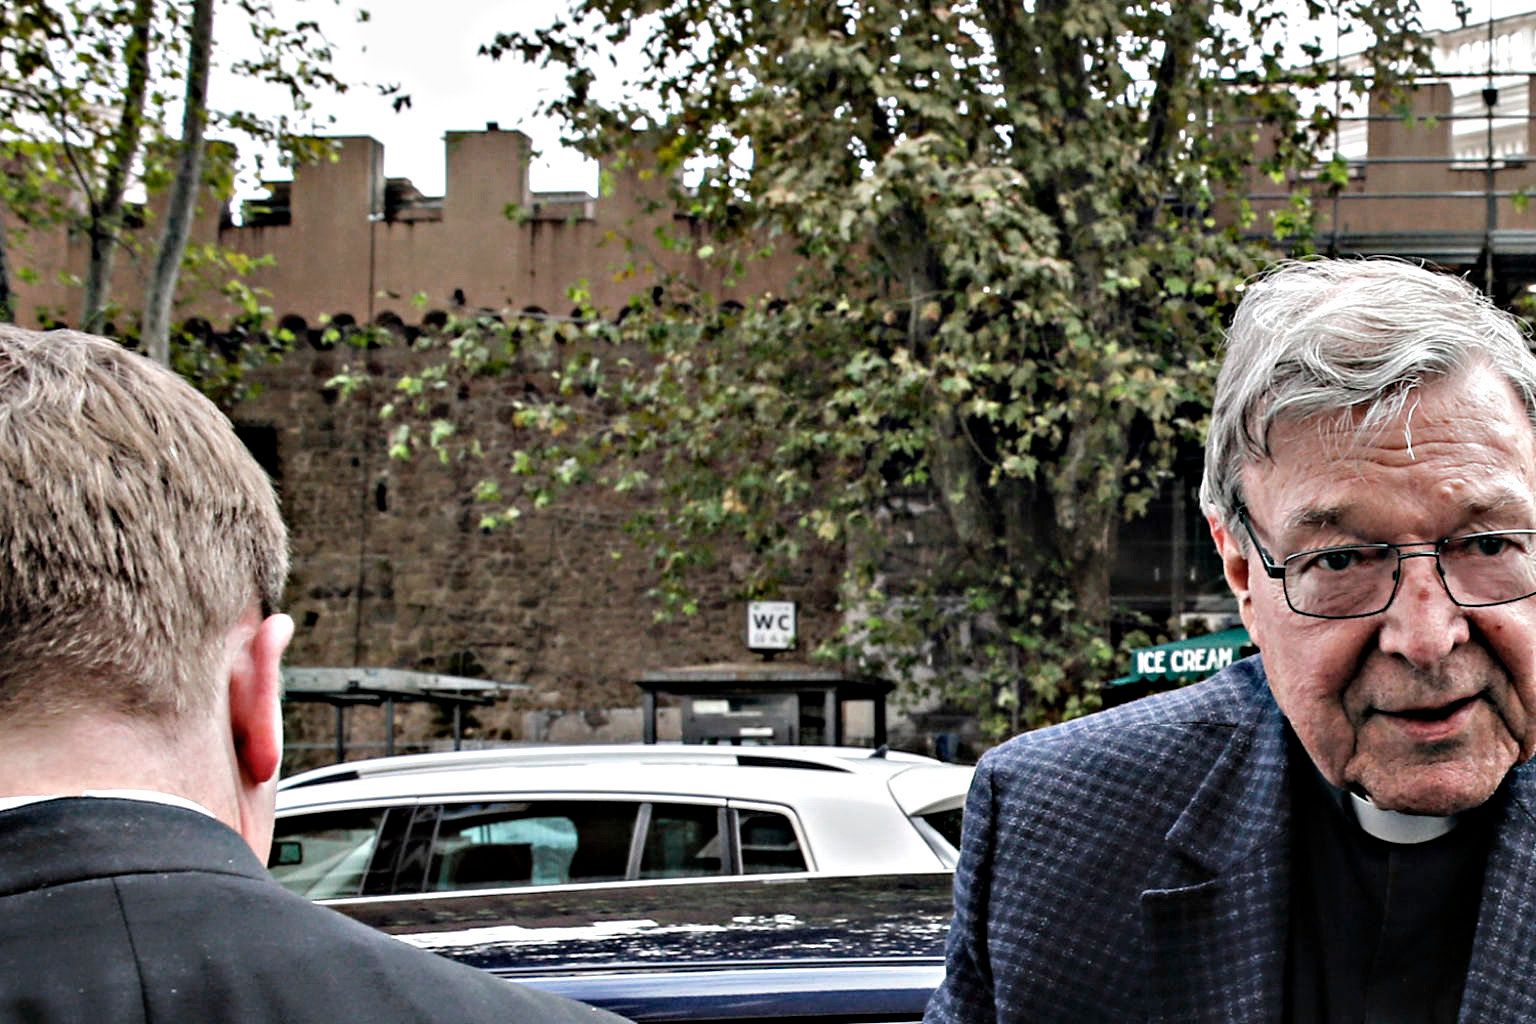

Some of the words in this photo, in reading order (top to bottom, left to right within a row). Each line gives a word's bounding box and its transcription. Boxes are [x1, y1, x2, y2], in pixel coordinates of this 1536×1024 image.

[753, 613, 790, 631] WC
[1137, 650, 1167, 674] ICE
[1170, 647, 1233, 673] CREAM
